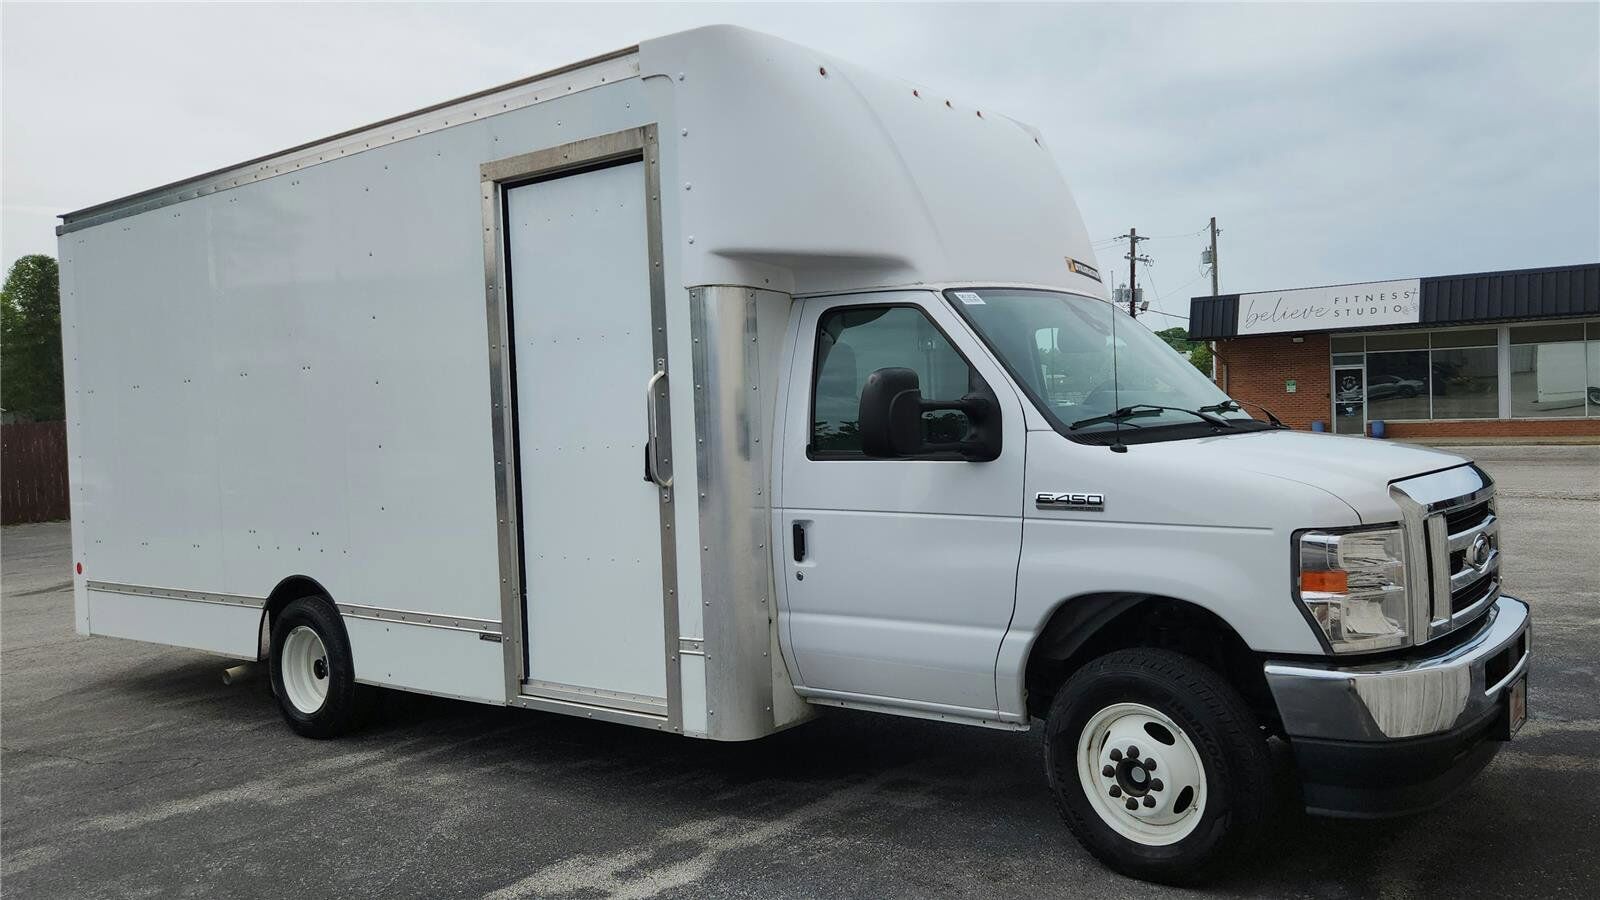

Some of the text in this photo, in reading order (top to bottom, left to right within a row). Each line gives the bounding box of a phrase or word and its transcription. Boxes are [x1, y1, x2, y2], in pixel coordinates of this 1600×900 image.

[1334, 291, 1410, 304] FITNESS
[1245, 297, 1330, 329] believe
[1334, 305, 1402, 317] STUDIO
